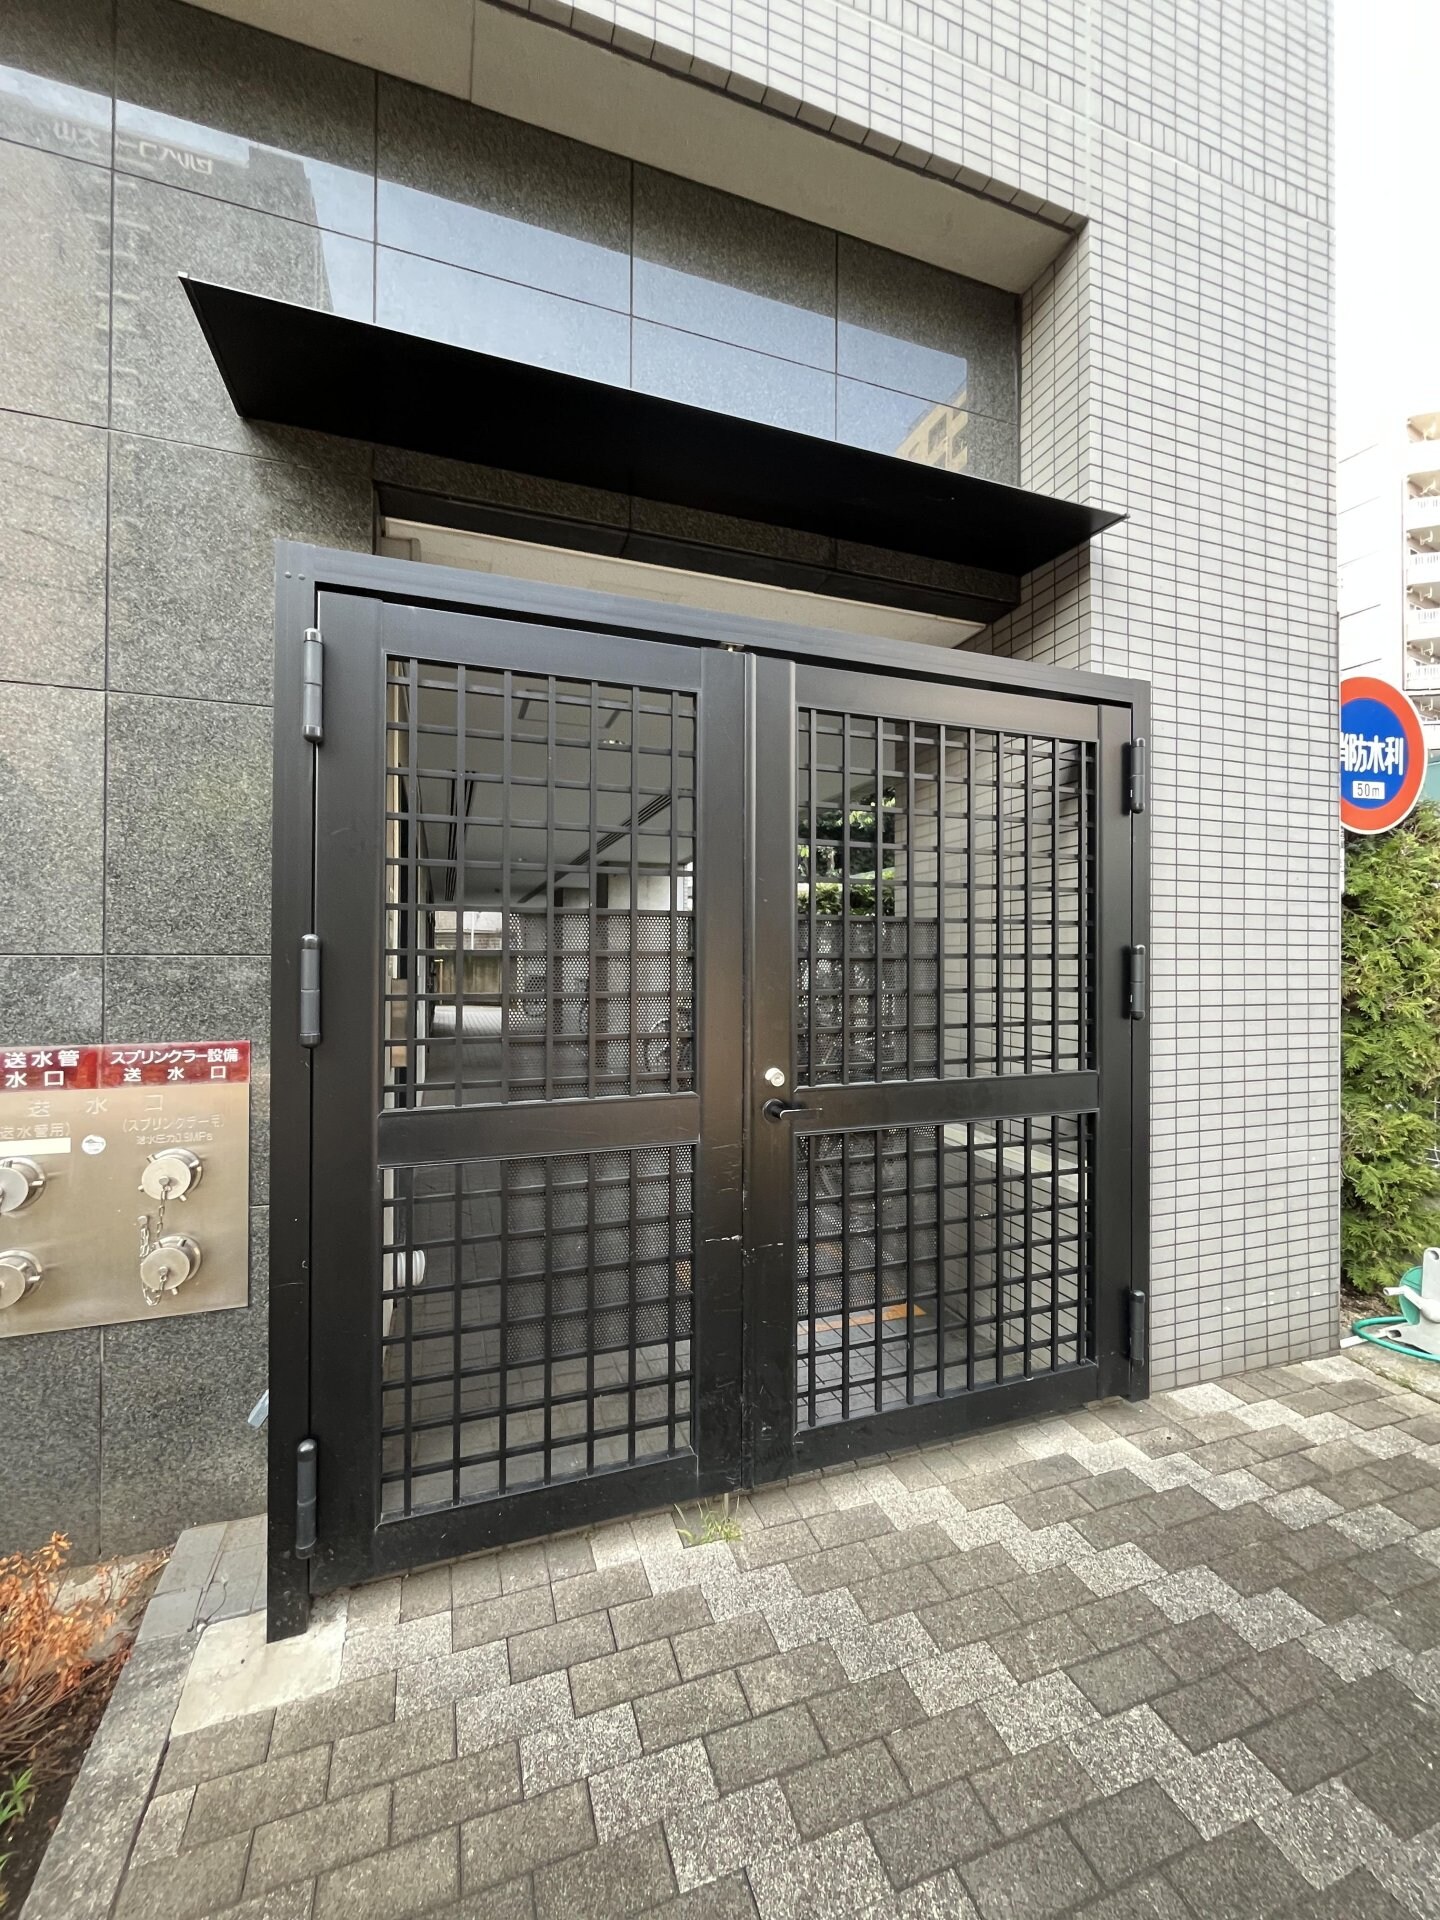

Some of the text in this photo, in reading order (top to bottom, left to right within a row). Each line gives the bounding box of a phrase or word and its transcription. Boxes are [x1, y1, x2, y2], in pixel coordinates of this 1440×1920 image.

[1357, 783, 1380, 797] 50m
[4, 1050, 80, 1069] 送水管
[110, 1048, 239, 1065] スプリンクラー設備
